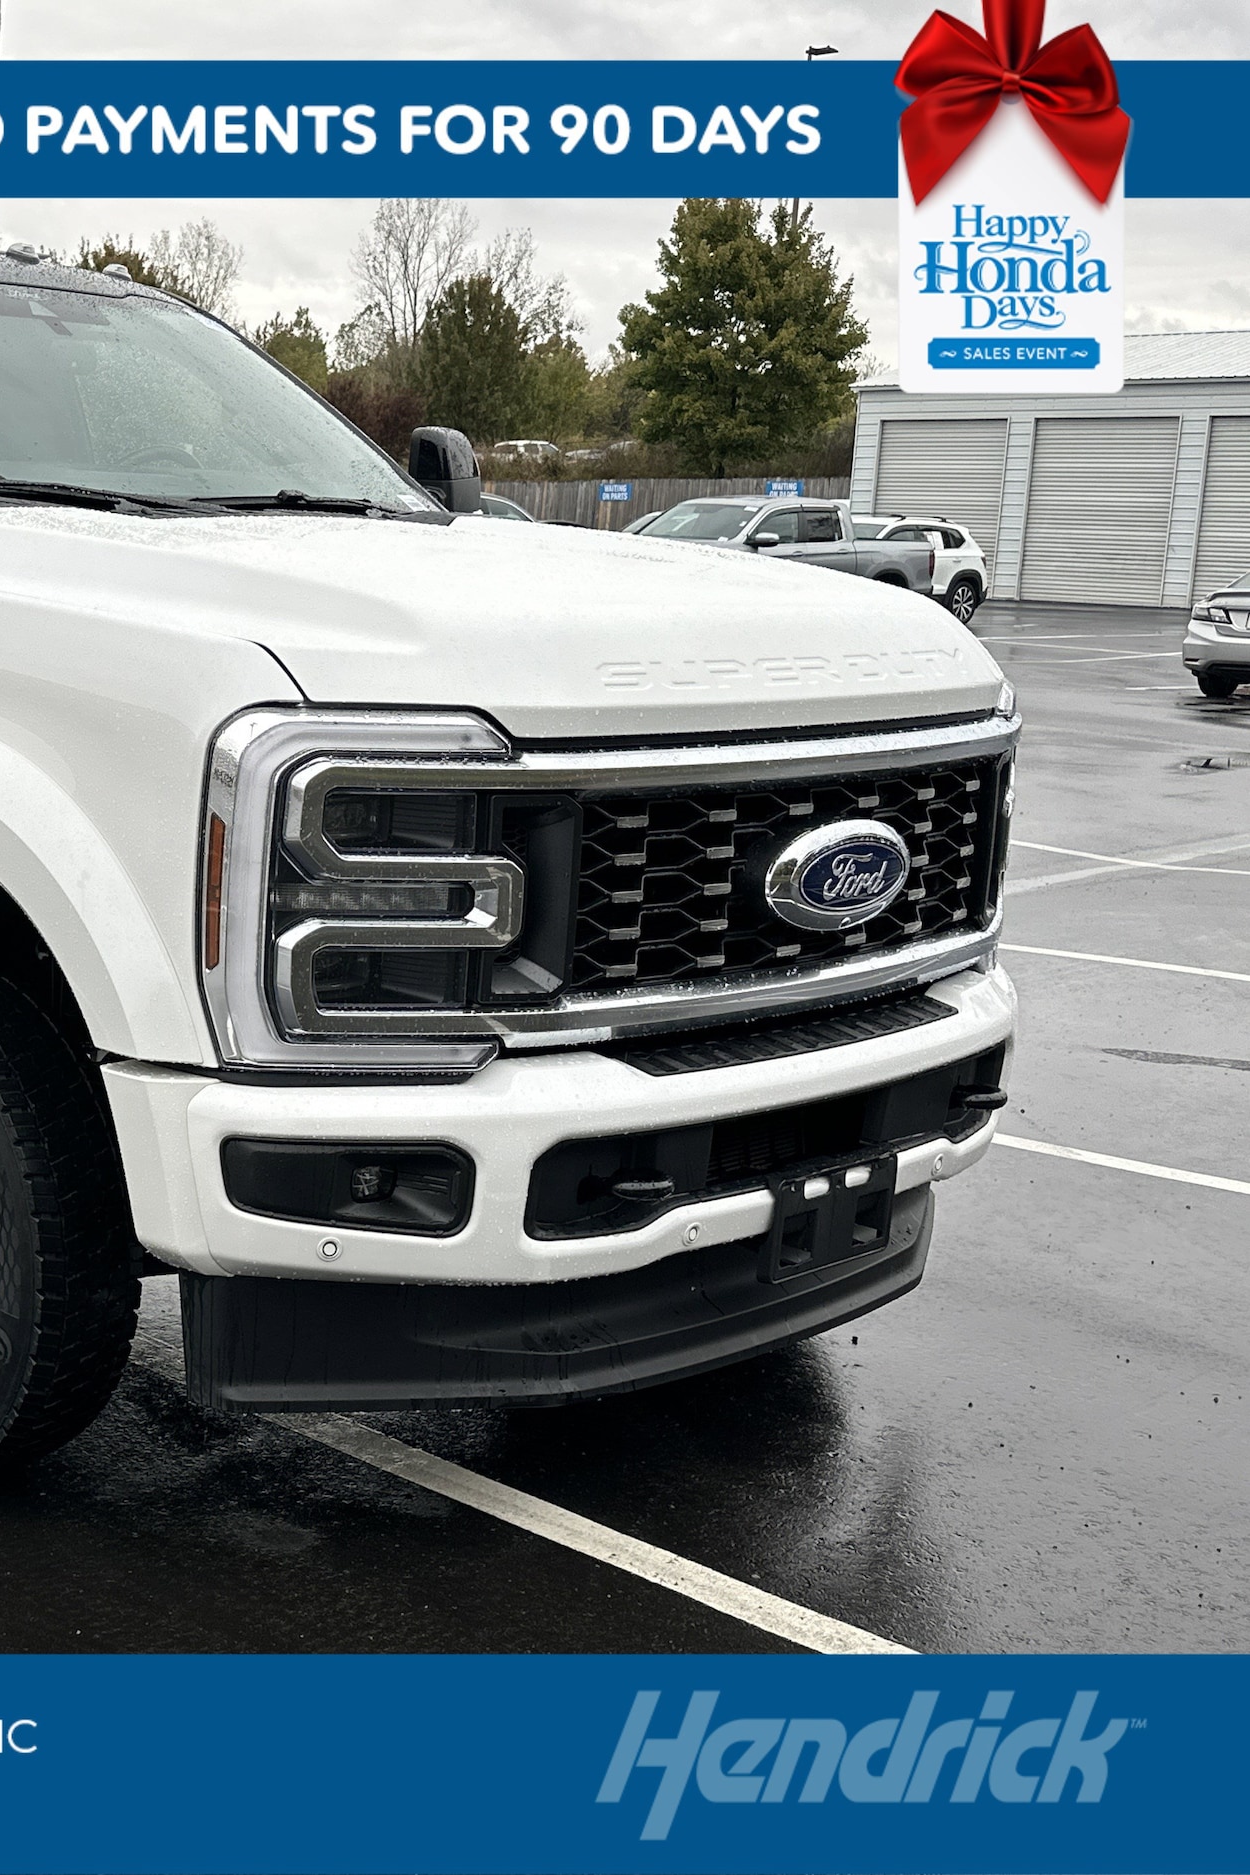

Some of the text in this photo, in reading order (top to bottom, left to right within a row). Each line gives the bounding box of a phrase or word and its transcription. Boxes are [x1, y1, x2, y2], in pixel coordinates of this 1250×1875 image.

[604, 484, 627, 493] WAITING
[771, 482, 798, 491] WAITING
[610, 492, 628, 501] PARTS
[595, 648, 970, 692] SUPER DUTY
[823, 850, 888, 903] Ford
